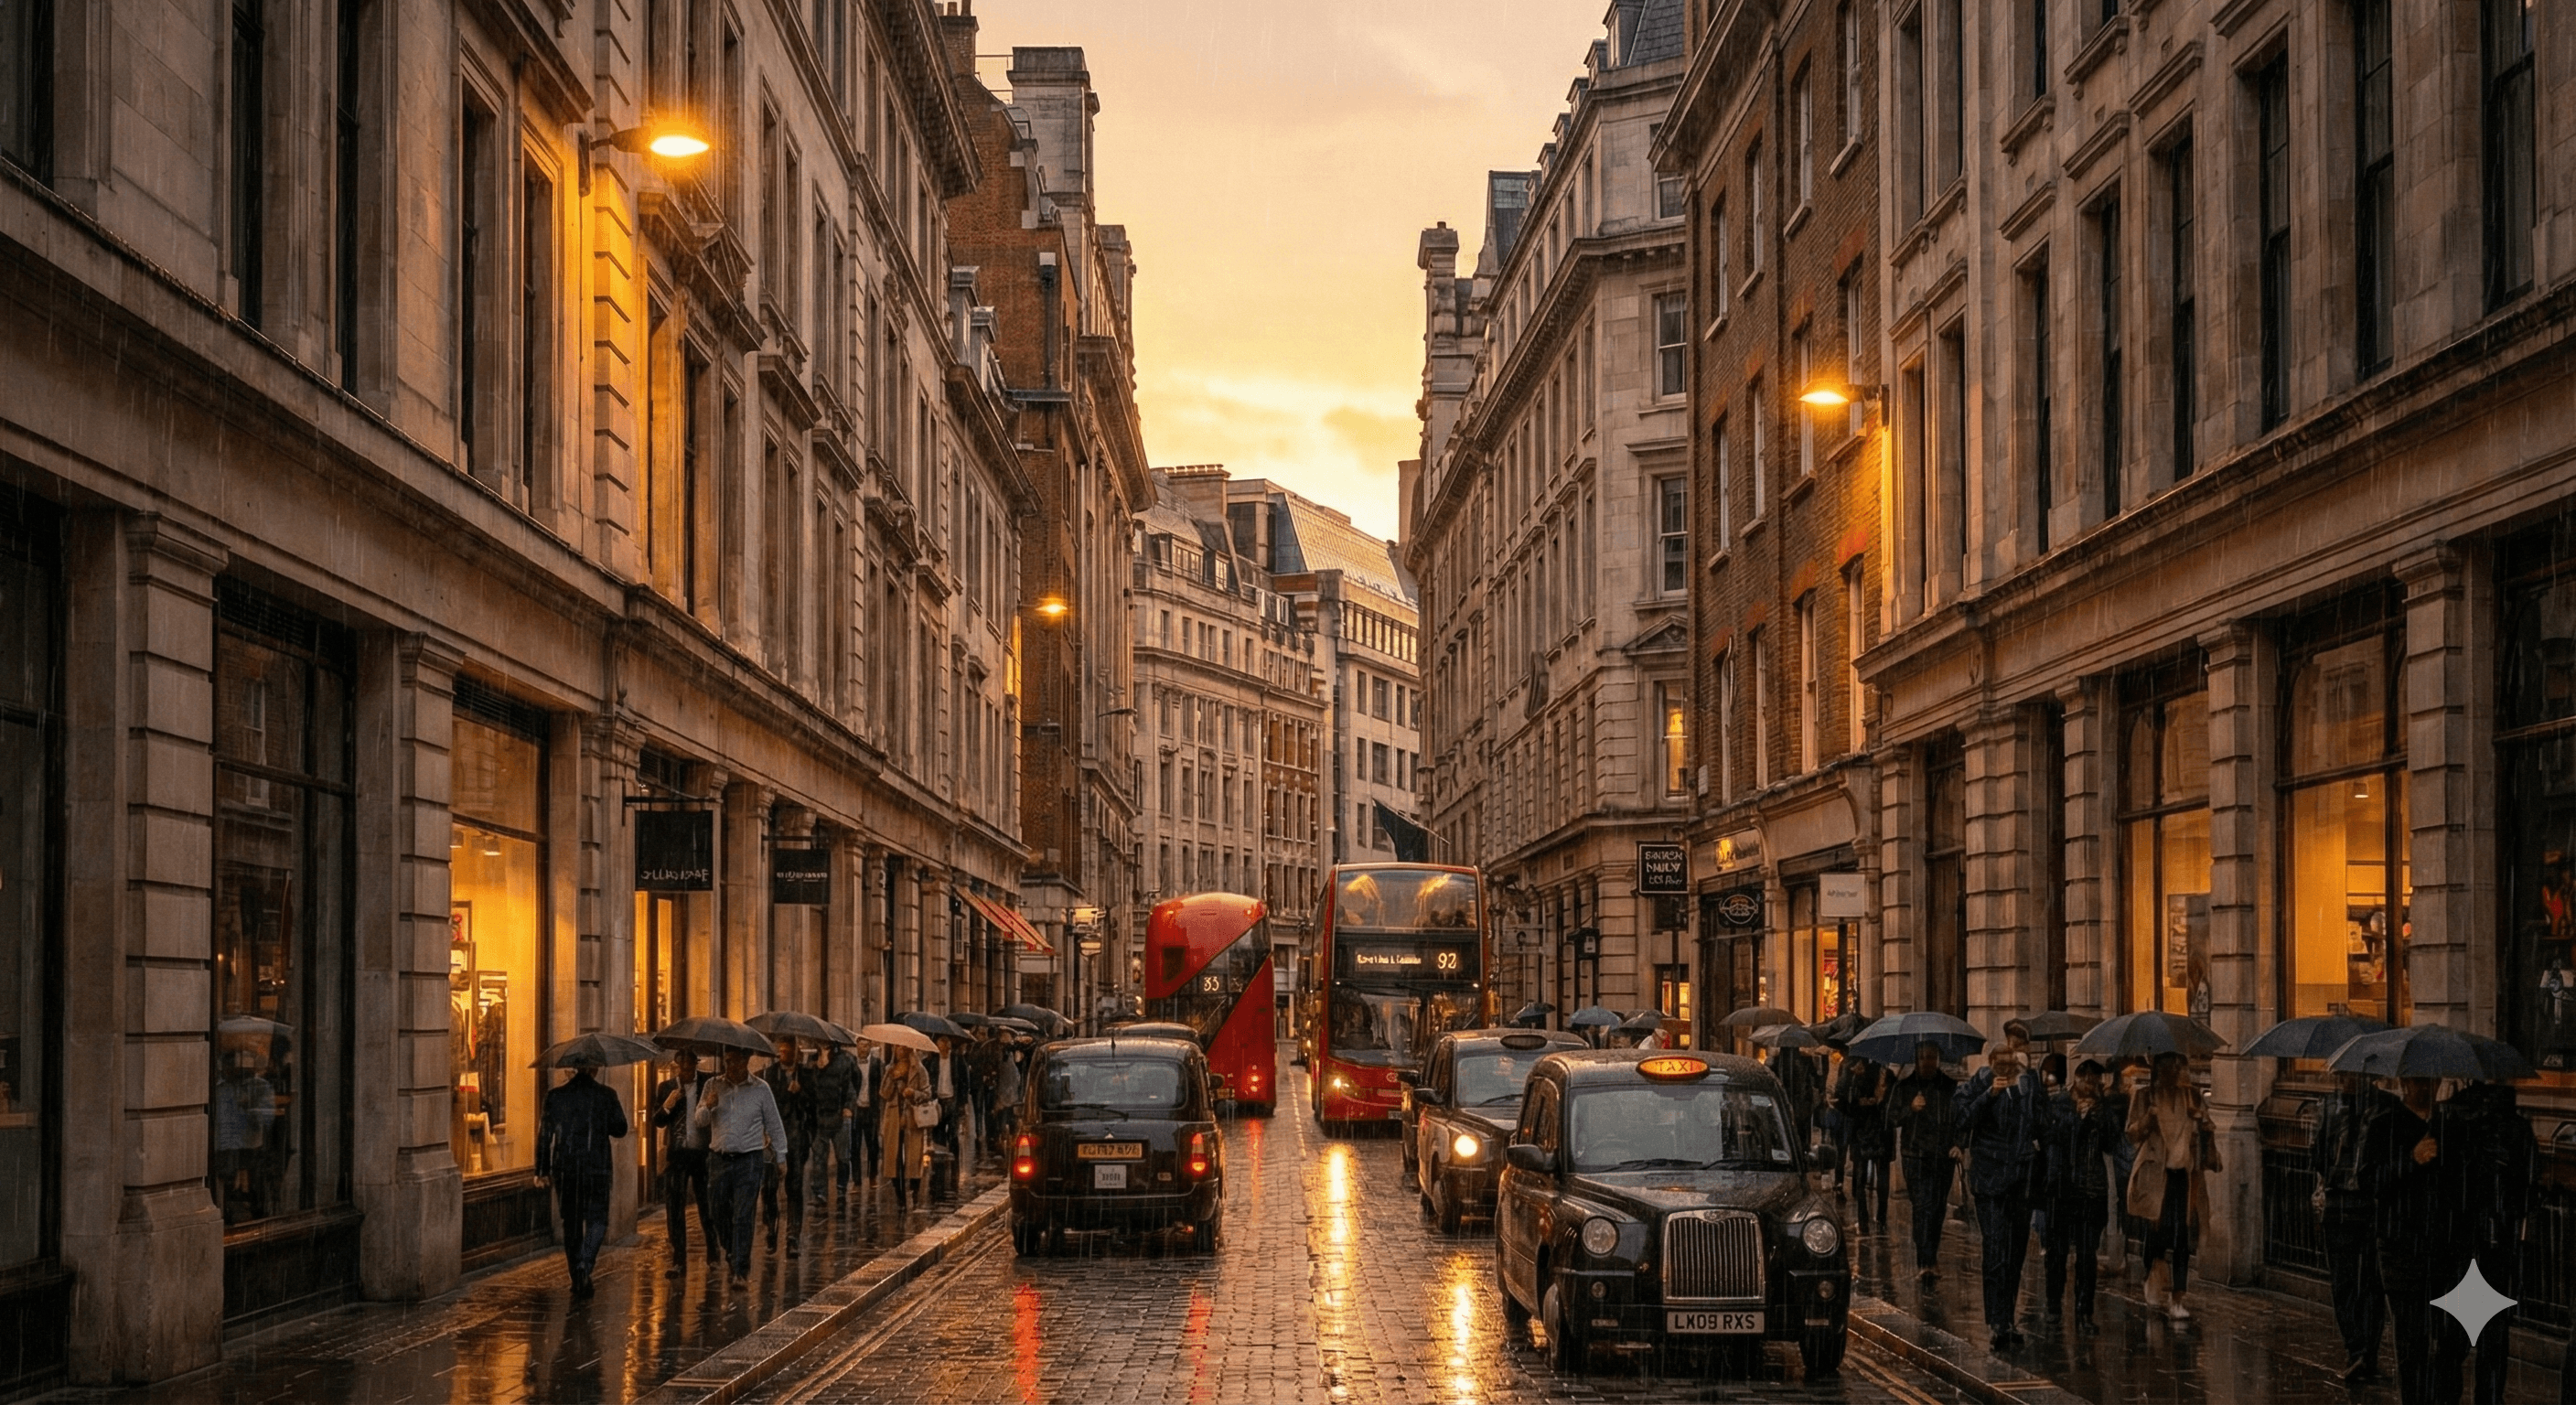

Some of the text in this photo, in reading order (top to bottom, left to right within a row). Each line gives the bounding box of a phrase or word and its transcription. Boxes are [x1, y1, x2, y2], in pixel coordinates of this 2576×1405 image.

[1438, 952, 1457, 970] 92
[1655, 1061, 1693, 1072] TAXI
[1723, 1314, 1755, 1330] RXS
